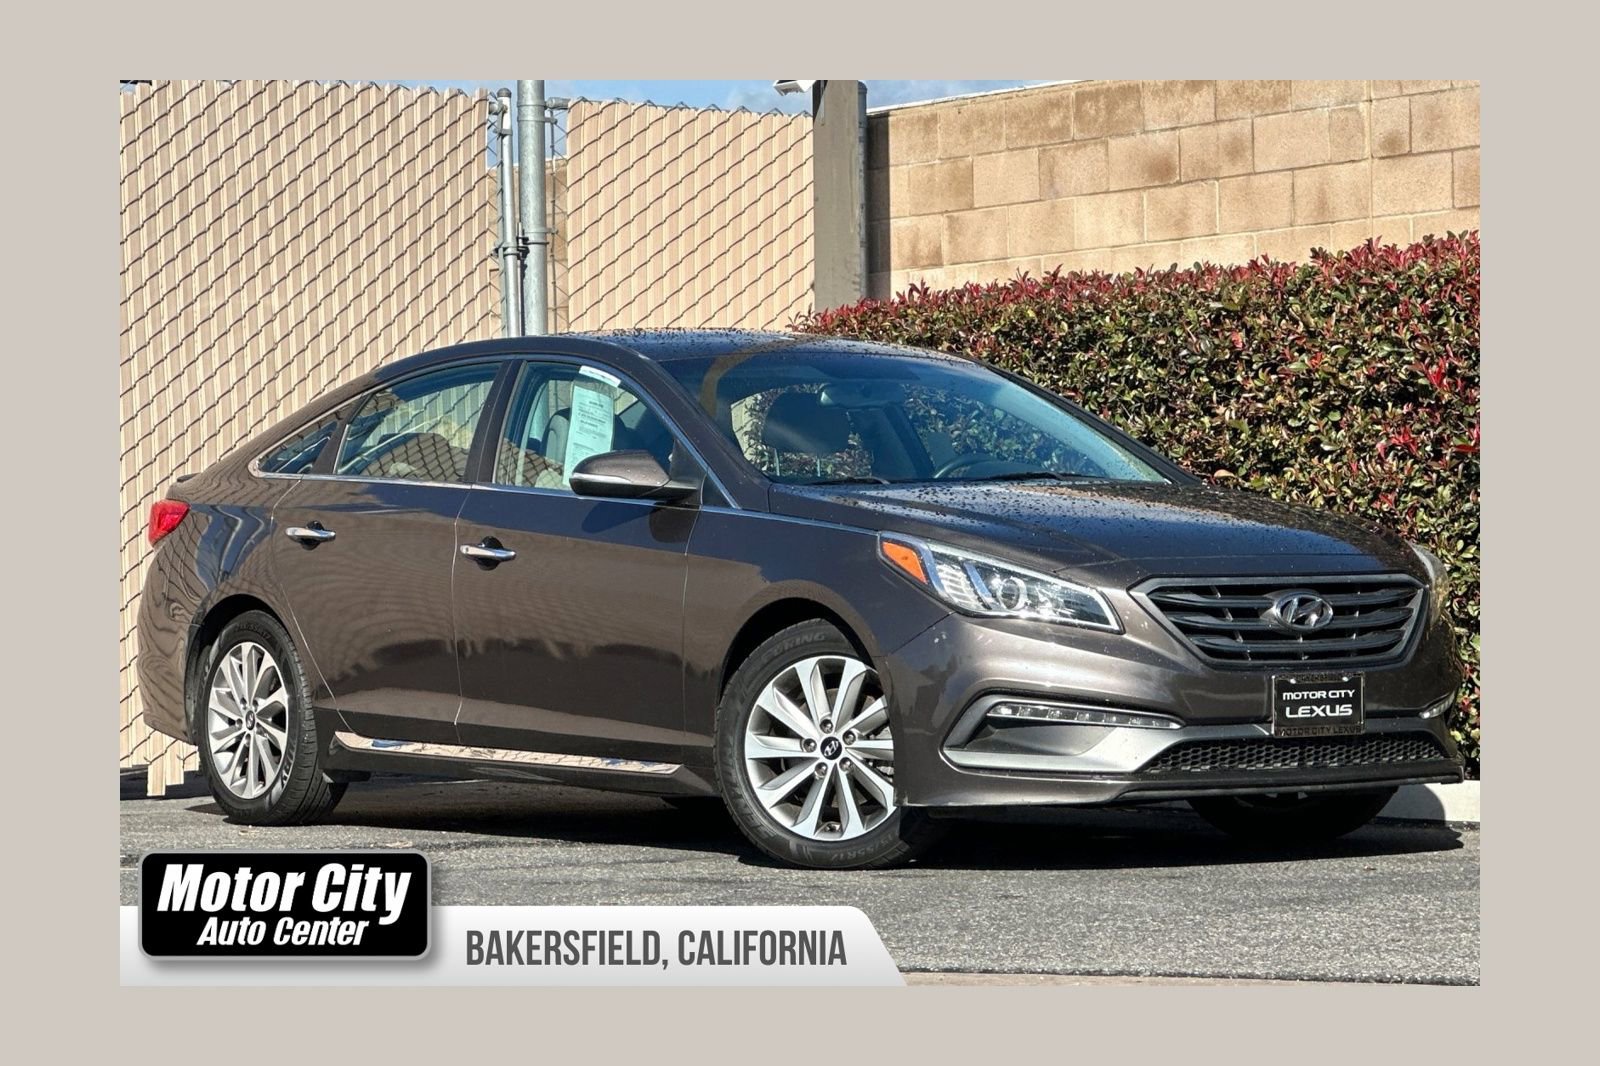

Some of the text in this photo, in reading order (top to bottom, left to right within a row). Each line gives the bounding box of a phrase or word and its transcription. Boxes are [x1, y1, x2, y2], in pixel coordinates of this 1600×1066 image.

[1282, 689, 1356, 701] MOTOR CITY
[1285, 704, 1353, 719] LEXUS
[1279, 725, 1361, 737] MOTOR CITY LEXUS
